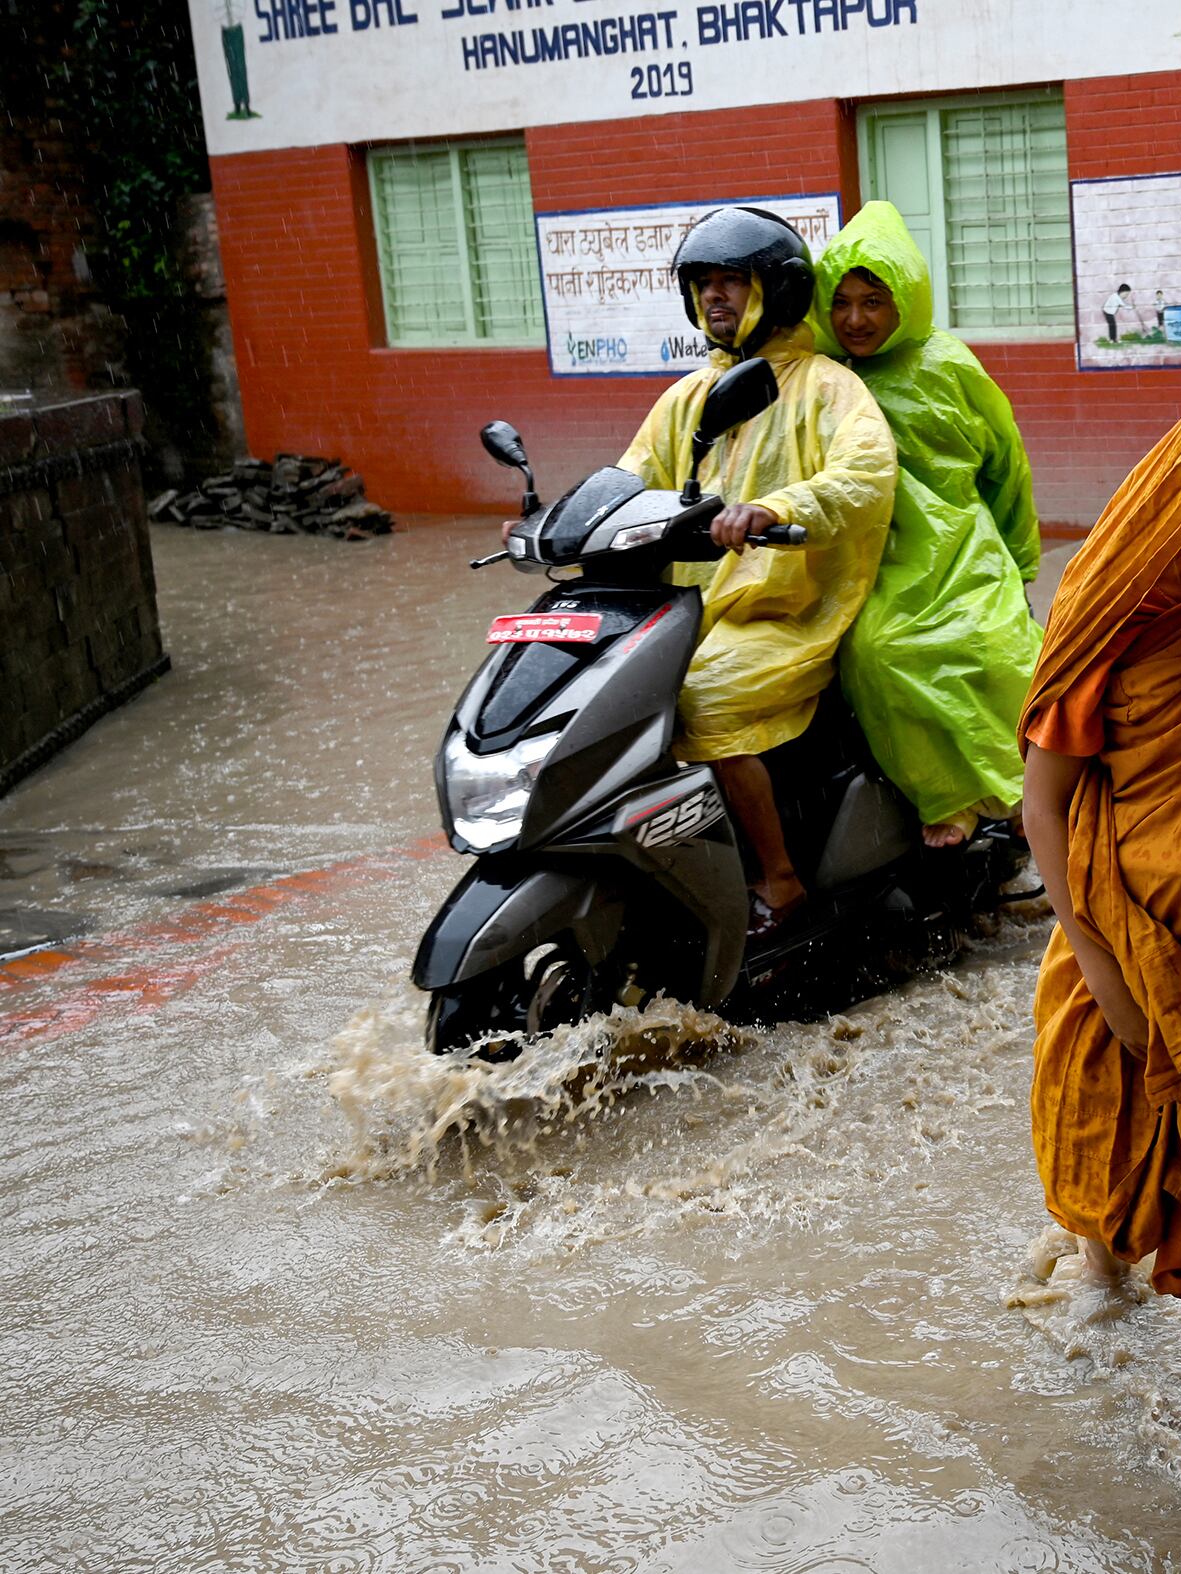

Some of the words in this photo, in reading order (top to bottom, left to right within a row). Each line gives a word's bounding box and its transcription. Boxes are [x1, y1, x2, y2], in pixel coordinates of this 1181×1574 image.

[254, 0, 338, 42] SHREE
[696, 0, 918, 46] BHAKTAPUR
[630, 61, 693, 100] 2019
[546, 230, 576, 258] धारा
[546, 266, 583, 305] पानी
[668, 335, 709, 359] Wate
[636, 790, 705, 848] 125
